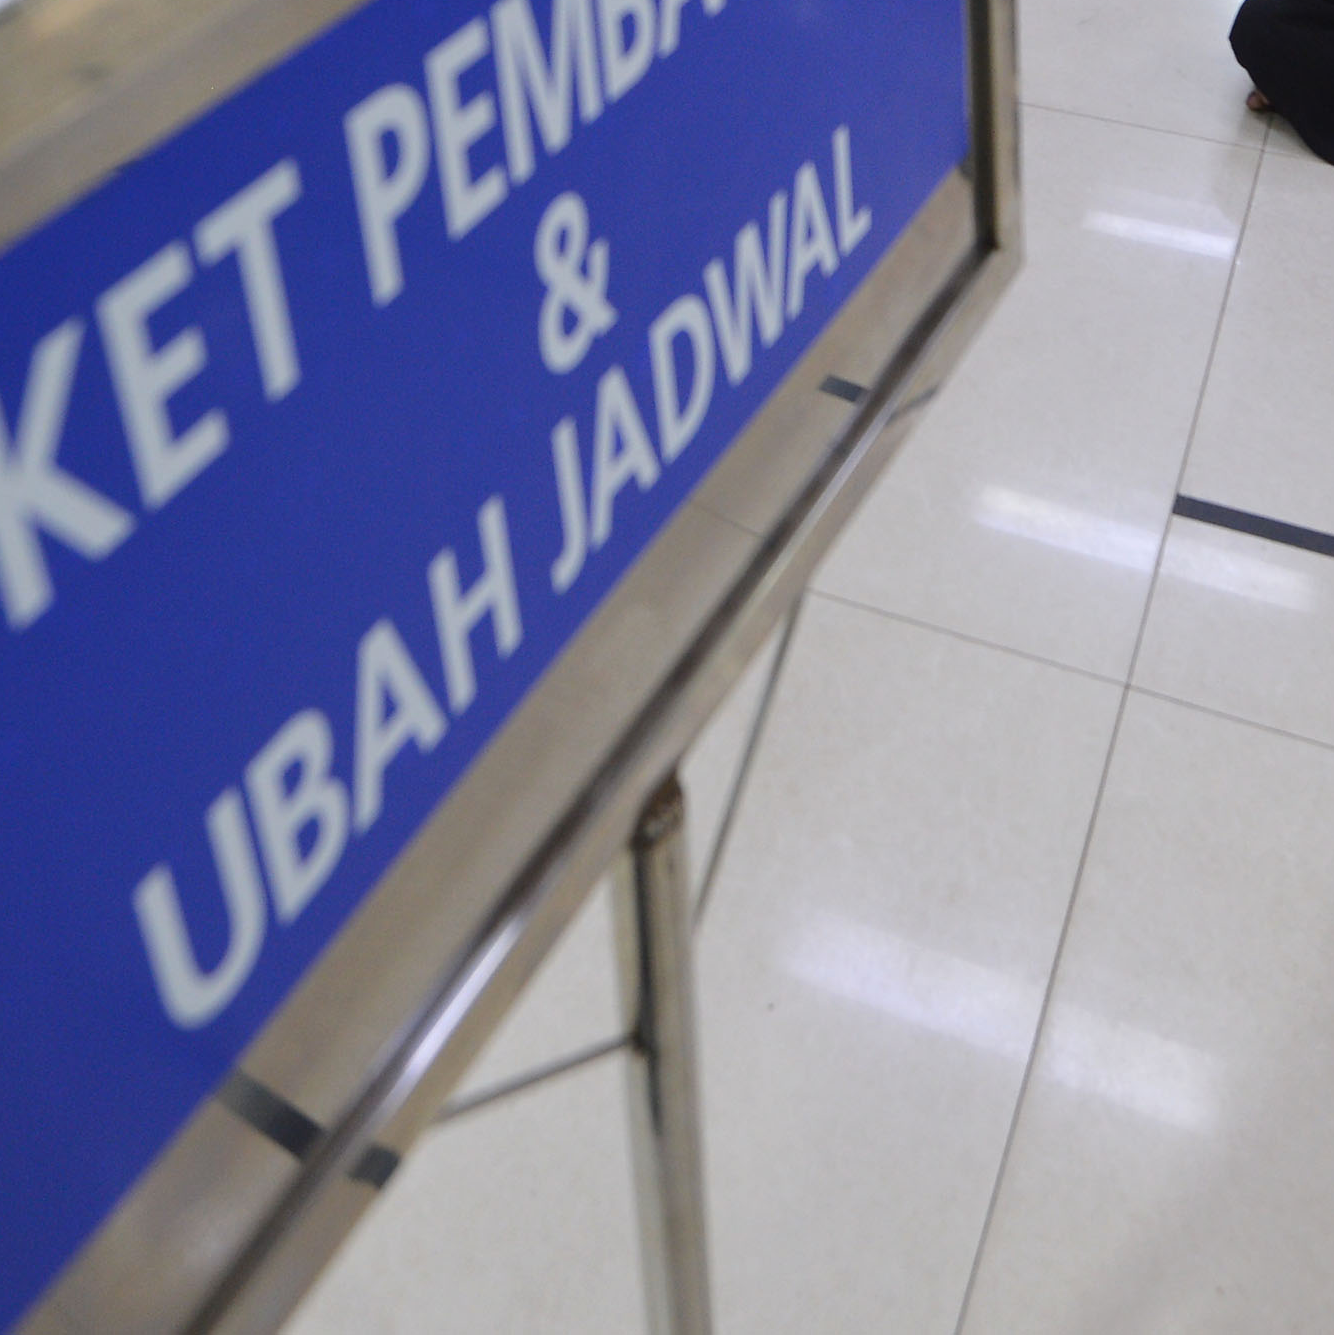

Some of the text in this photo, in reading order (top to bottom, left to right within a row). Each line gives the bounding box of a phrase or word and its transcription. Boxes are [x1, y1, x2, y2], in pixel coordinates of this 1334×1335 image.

[534, 191, 617, 373] &
[132, 123, 874, 1028] UBAH JADWAL
